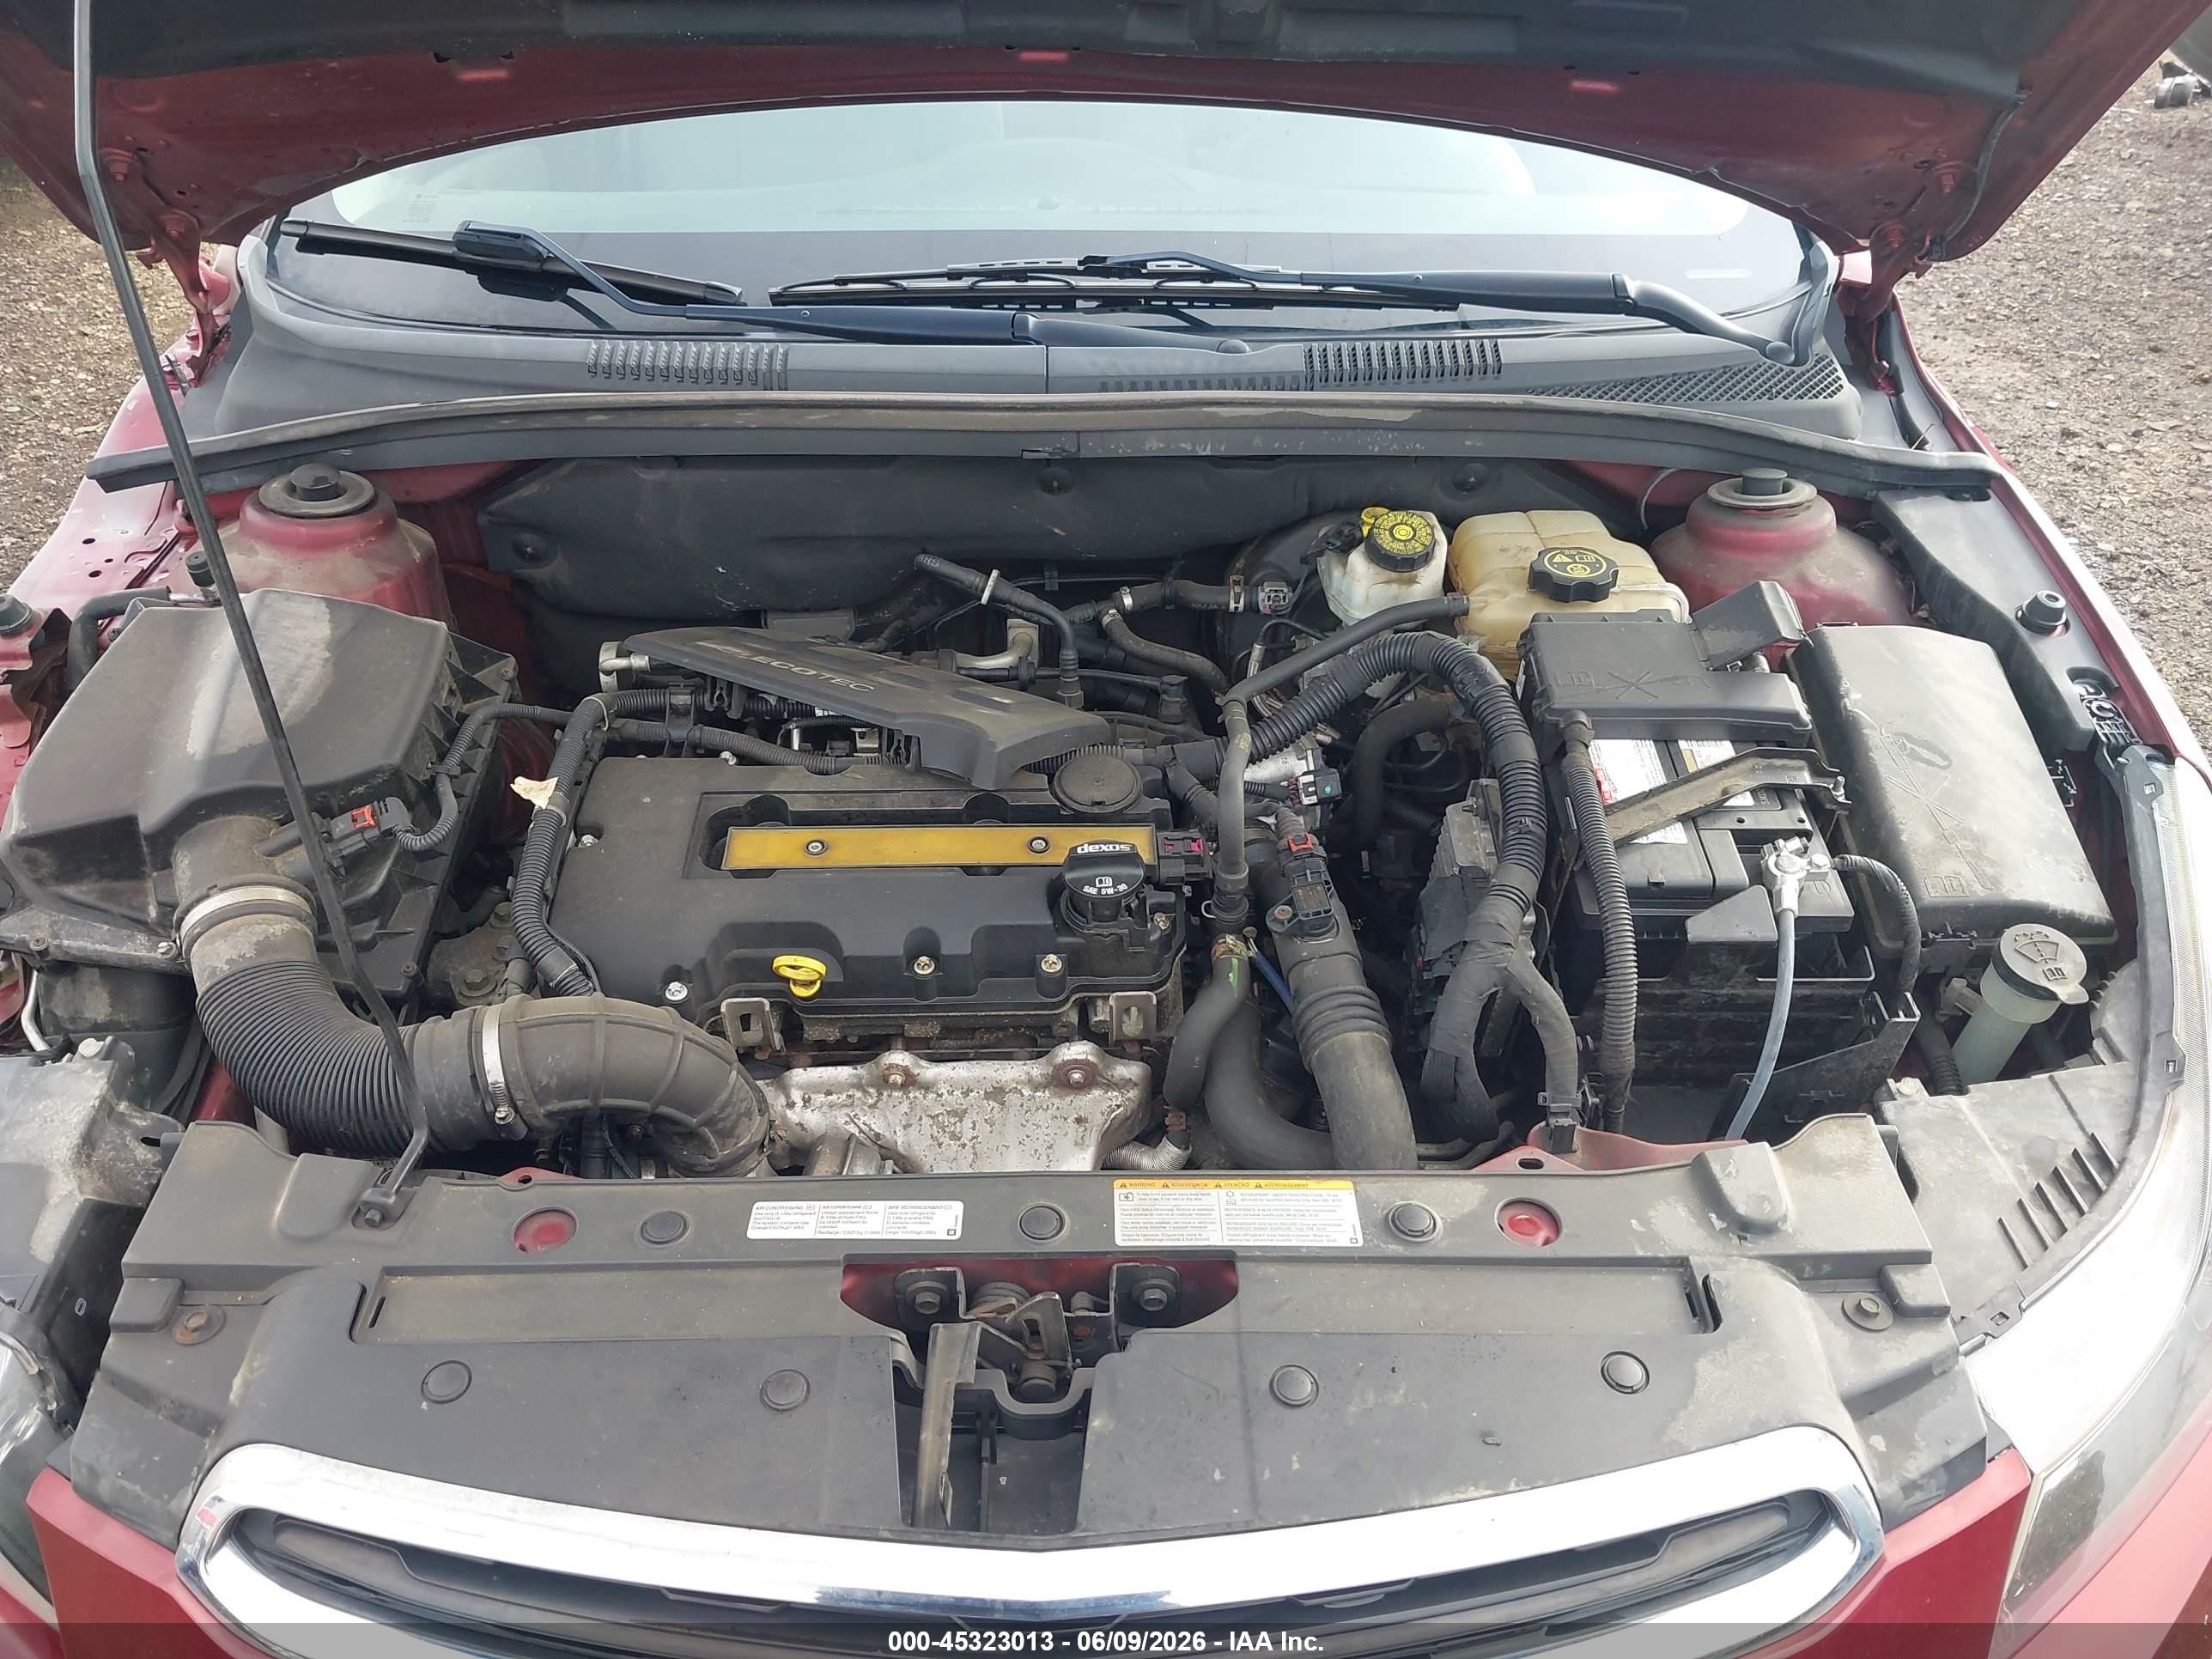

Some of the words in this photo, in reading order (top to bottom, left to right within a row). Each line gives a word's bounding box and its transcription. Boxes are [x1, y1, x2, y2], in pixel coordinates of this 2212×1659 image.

[750, 656, 874, 691] ECOTEC
[1077, 843, 1133, 854] dexos
[1083, 885, 1098, 894] SAE
[1101, 883, 1128, 894] 5W-30
